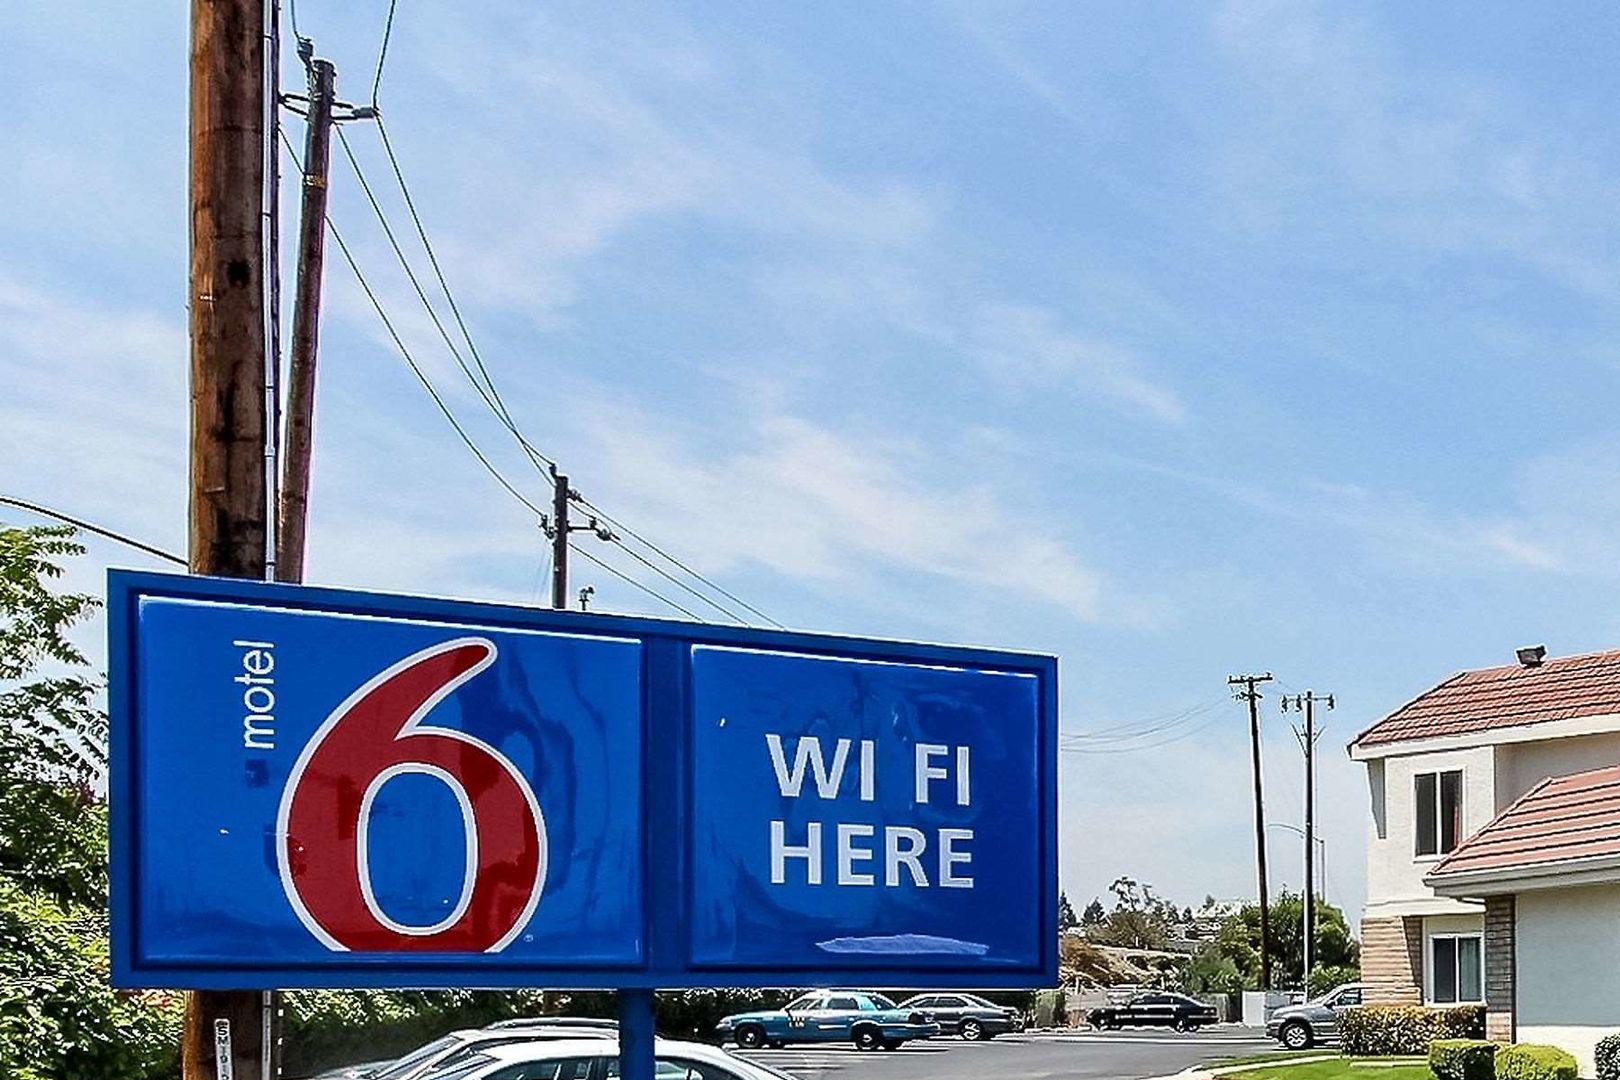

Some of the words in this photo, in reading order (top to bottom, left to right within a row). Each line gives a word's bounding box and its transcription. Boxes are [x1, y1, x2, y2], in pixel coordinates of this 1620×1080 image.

[232, 639, 275, 749] motel
[277, 637, 548, 953] 6
[765, 733, 875, 802] WI
[915, 743, 970, 806] FI
[770, 820, 974, 888] HERE
